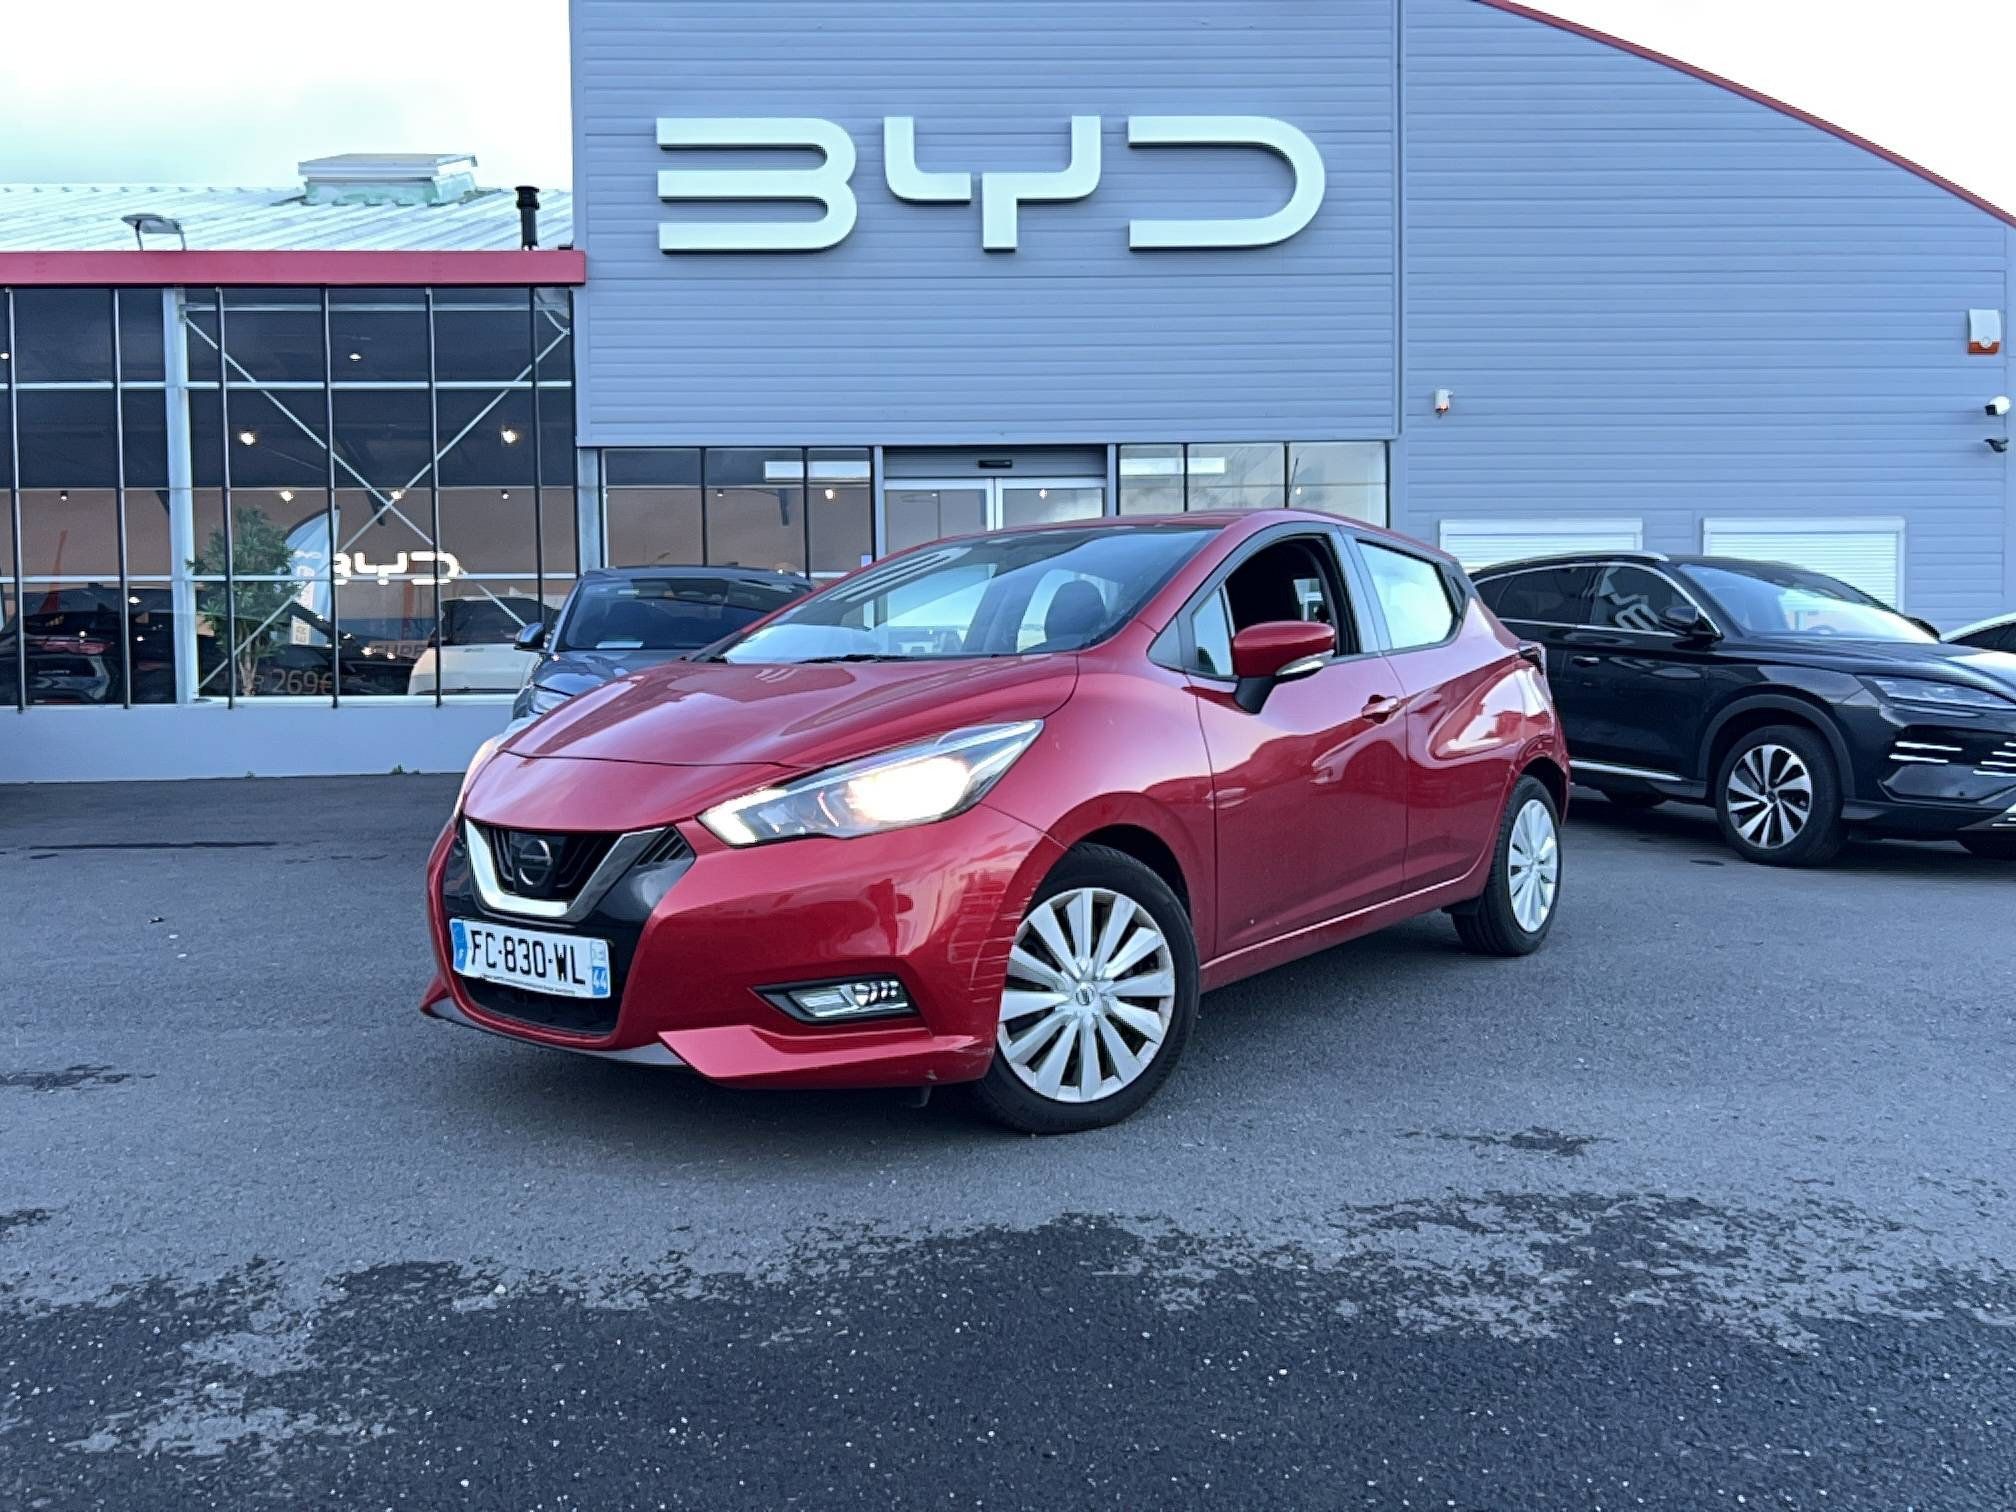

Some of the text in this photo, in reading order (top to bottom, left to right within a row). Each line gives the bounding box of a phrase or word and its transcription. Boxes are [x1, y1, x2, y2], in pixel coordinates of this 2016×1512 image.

[656, 115, 1326, 252] BYD
[471, 930, 585, 985] FC-830-WL
[594, 969, 607, 989] 44
